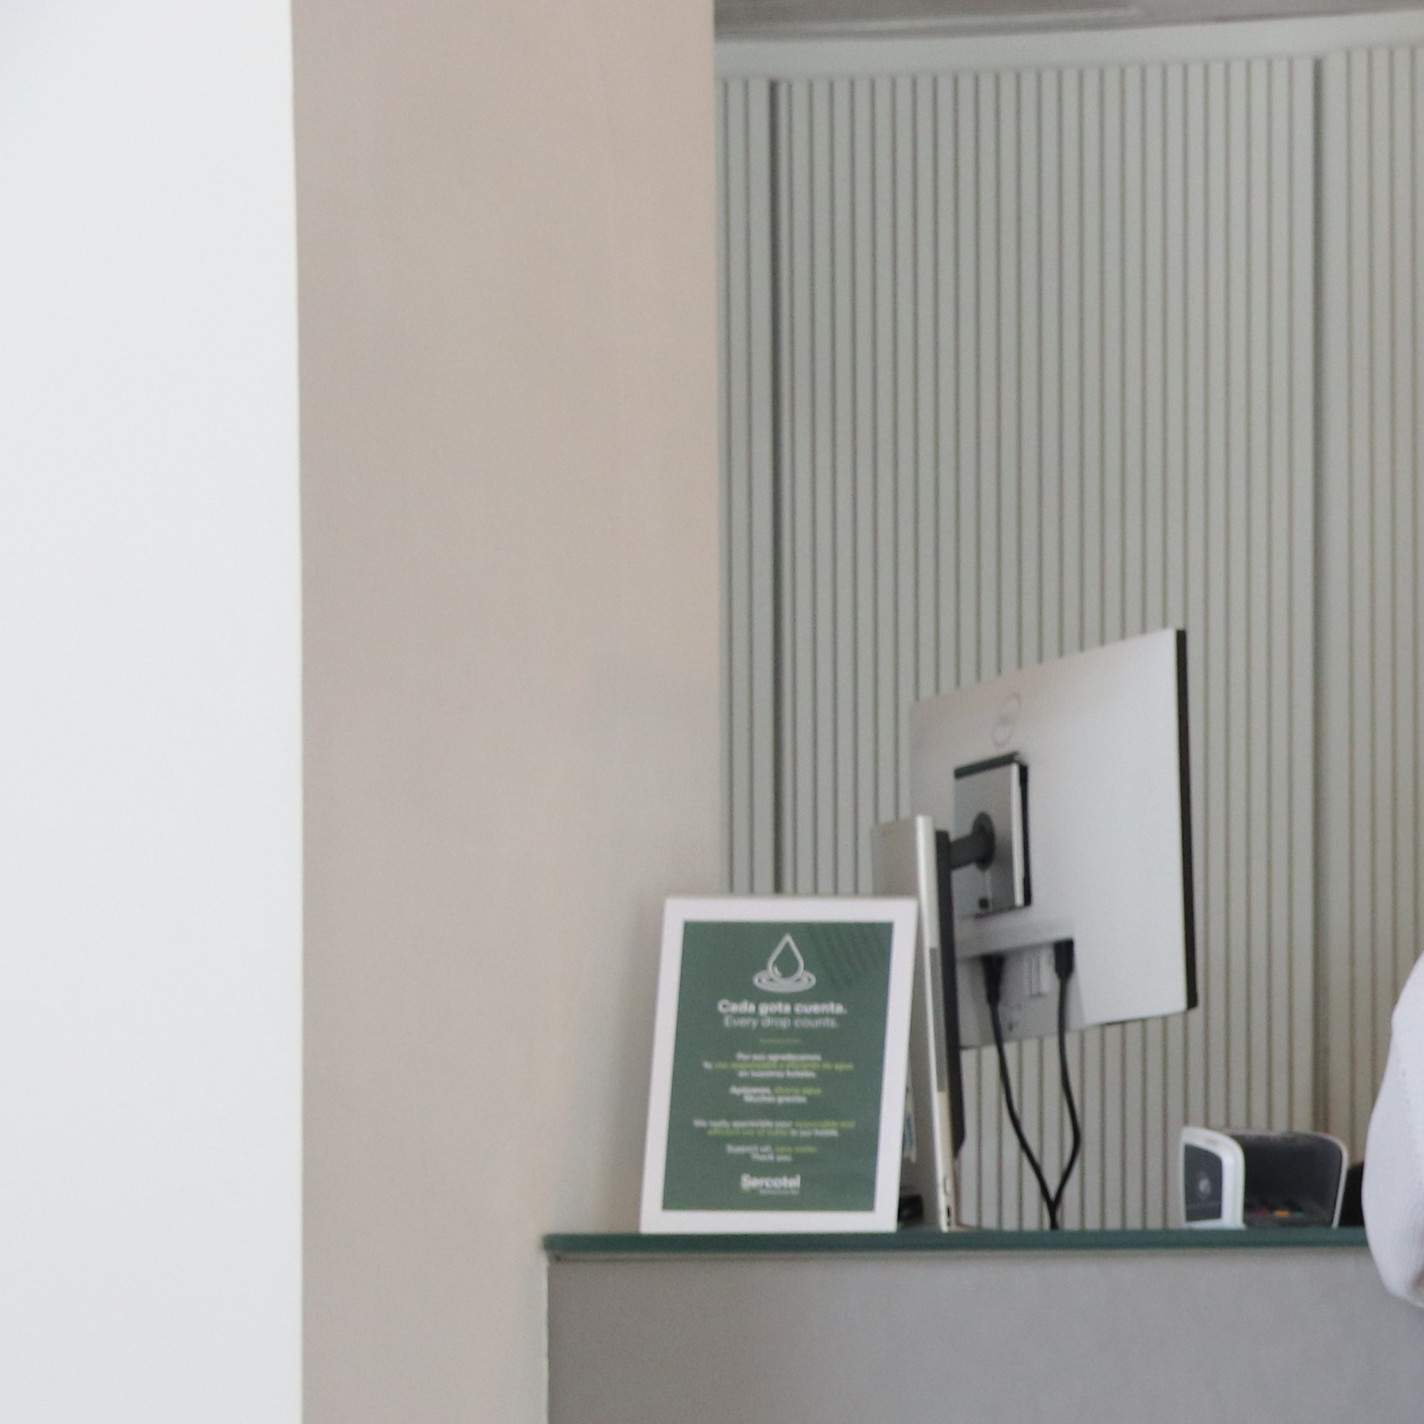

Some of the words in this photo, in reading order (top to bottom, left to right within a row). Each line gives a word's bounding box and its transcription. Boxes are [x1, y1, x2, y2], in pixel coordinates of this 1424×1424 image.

[717, 999, 756, 1015] Cada
[758, 1002, 792, 1017] gota
[724, 1015, 758, 1030] Every
[760, 1015, 792, 1029] drop
[741, 1173, 801, 1190] Sercotel
